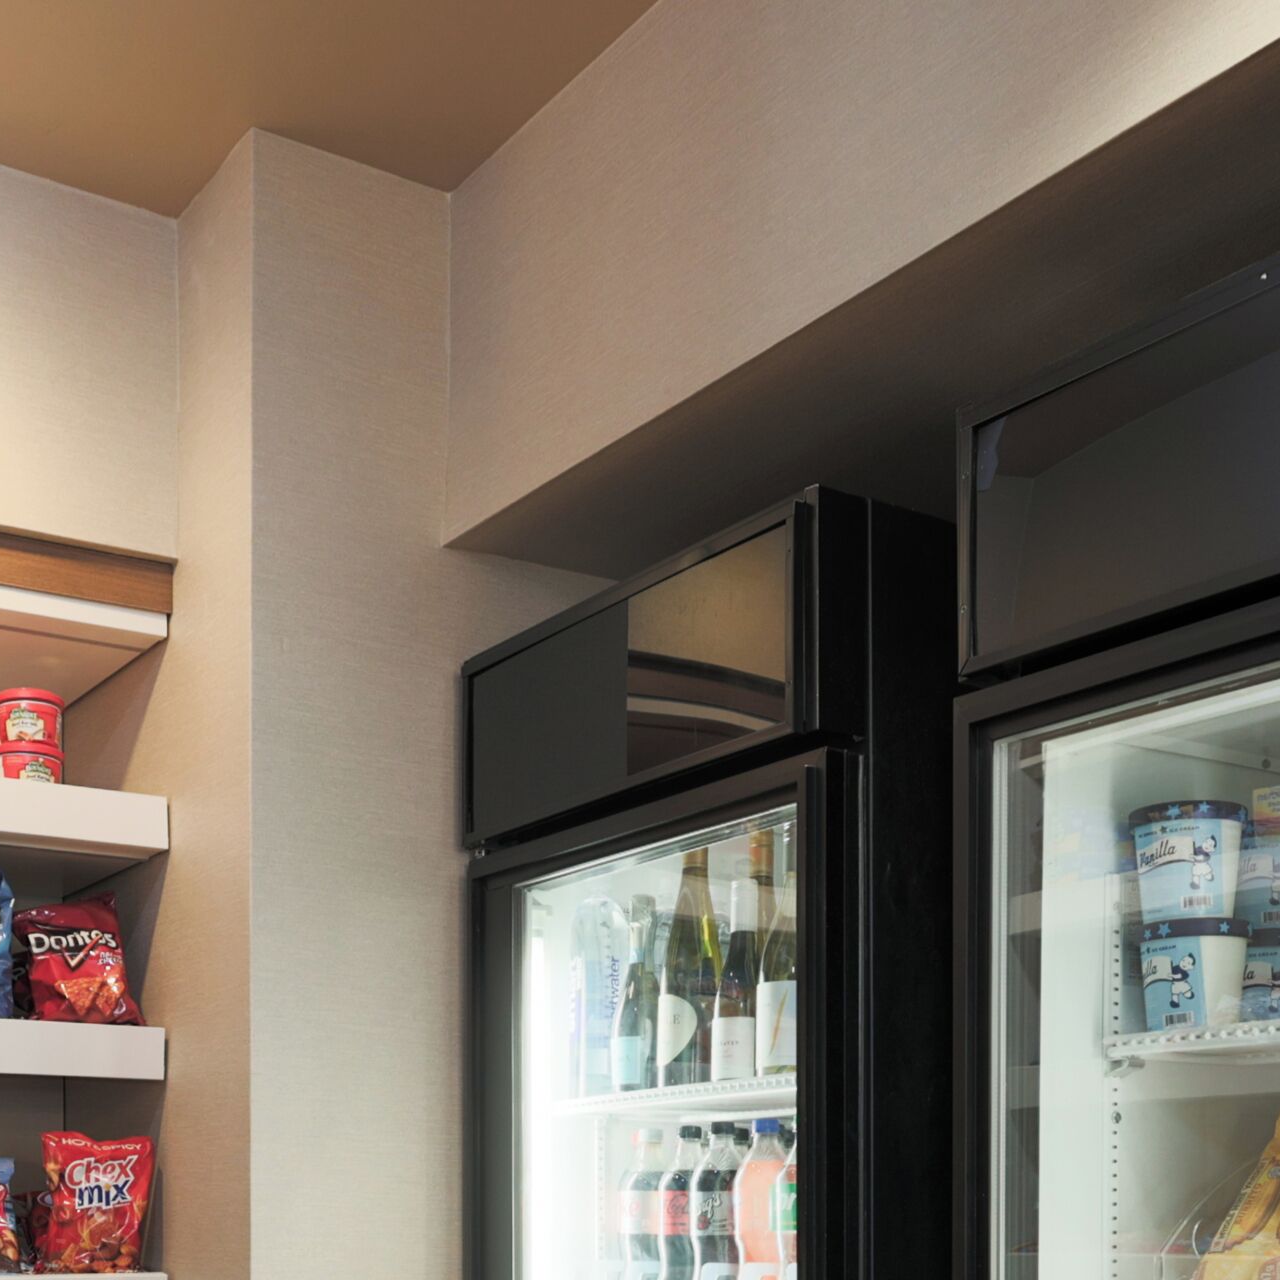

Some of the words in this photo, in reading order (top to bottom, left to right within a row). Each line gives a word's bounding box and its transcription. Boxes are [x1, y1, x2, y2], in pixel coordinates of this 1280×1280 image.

[1139, 839, 1178, 868] Vanilla
[28, 930, 118, 954] Doritos
[61, 1137, 90, 1147] HOT
[101, 1143, 142, 1151] SPICY
[66, 1155, 138, 1189] Chex
[75, 1180, 132, 1210] mix
